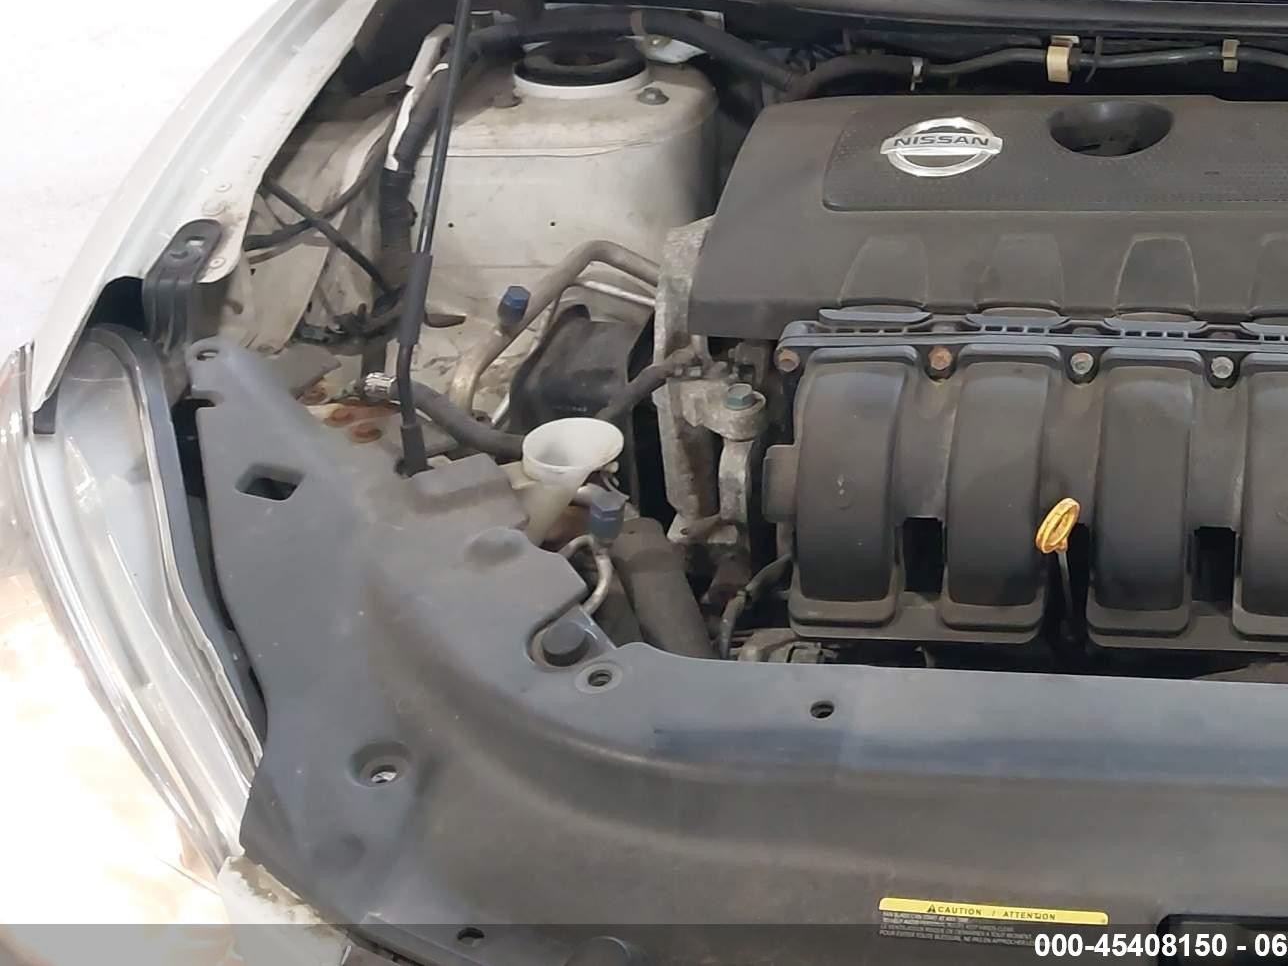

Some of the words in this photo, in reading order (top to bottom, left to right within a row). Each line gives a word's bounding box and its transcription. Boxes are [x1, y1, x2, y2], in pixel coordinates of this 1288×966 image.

[893, 134, 990, 147] NISSAN
[937, 906, 983, 916] CAUTION
[1002, 910, 1057, 921] ATTENTION
